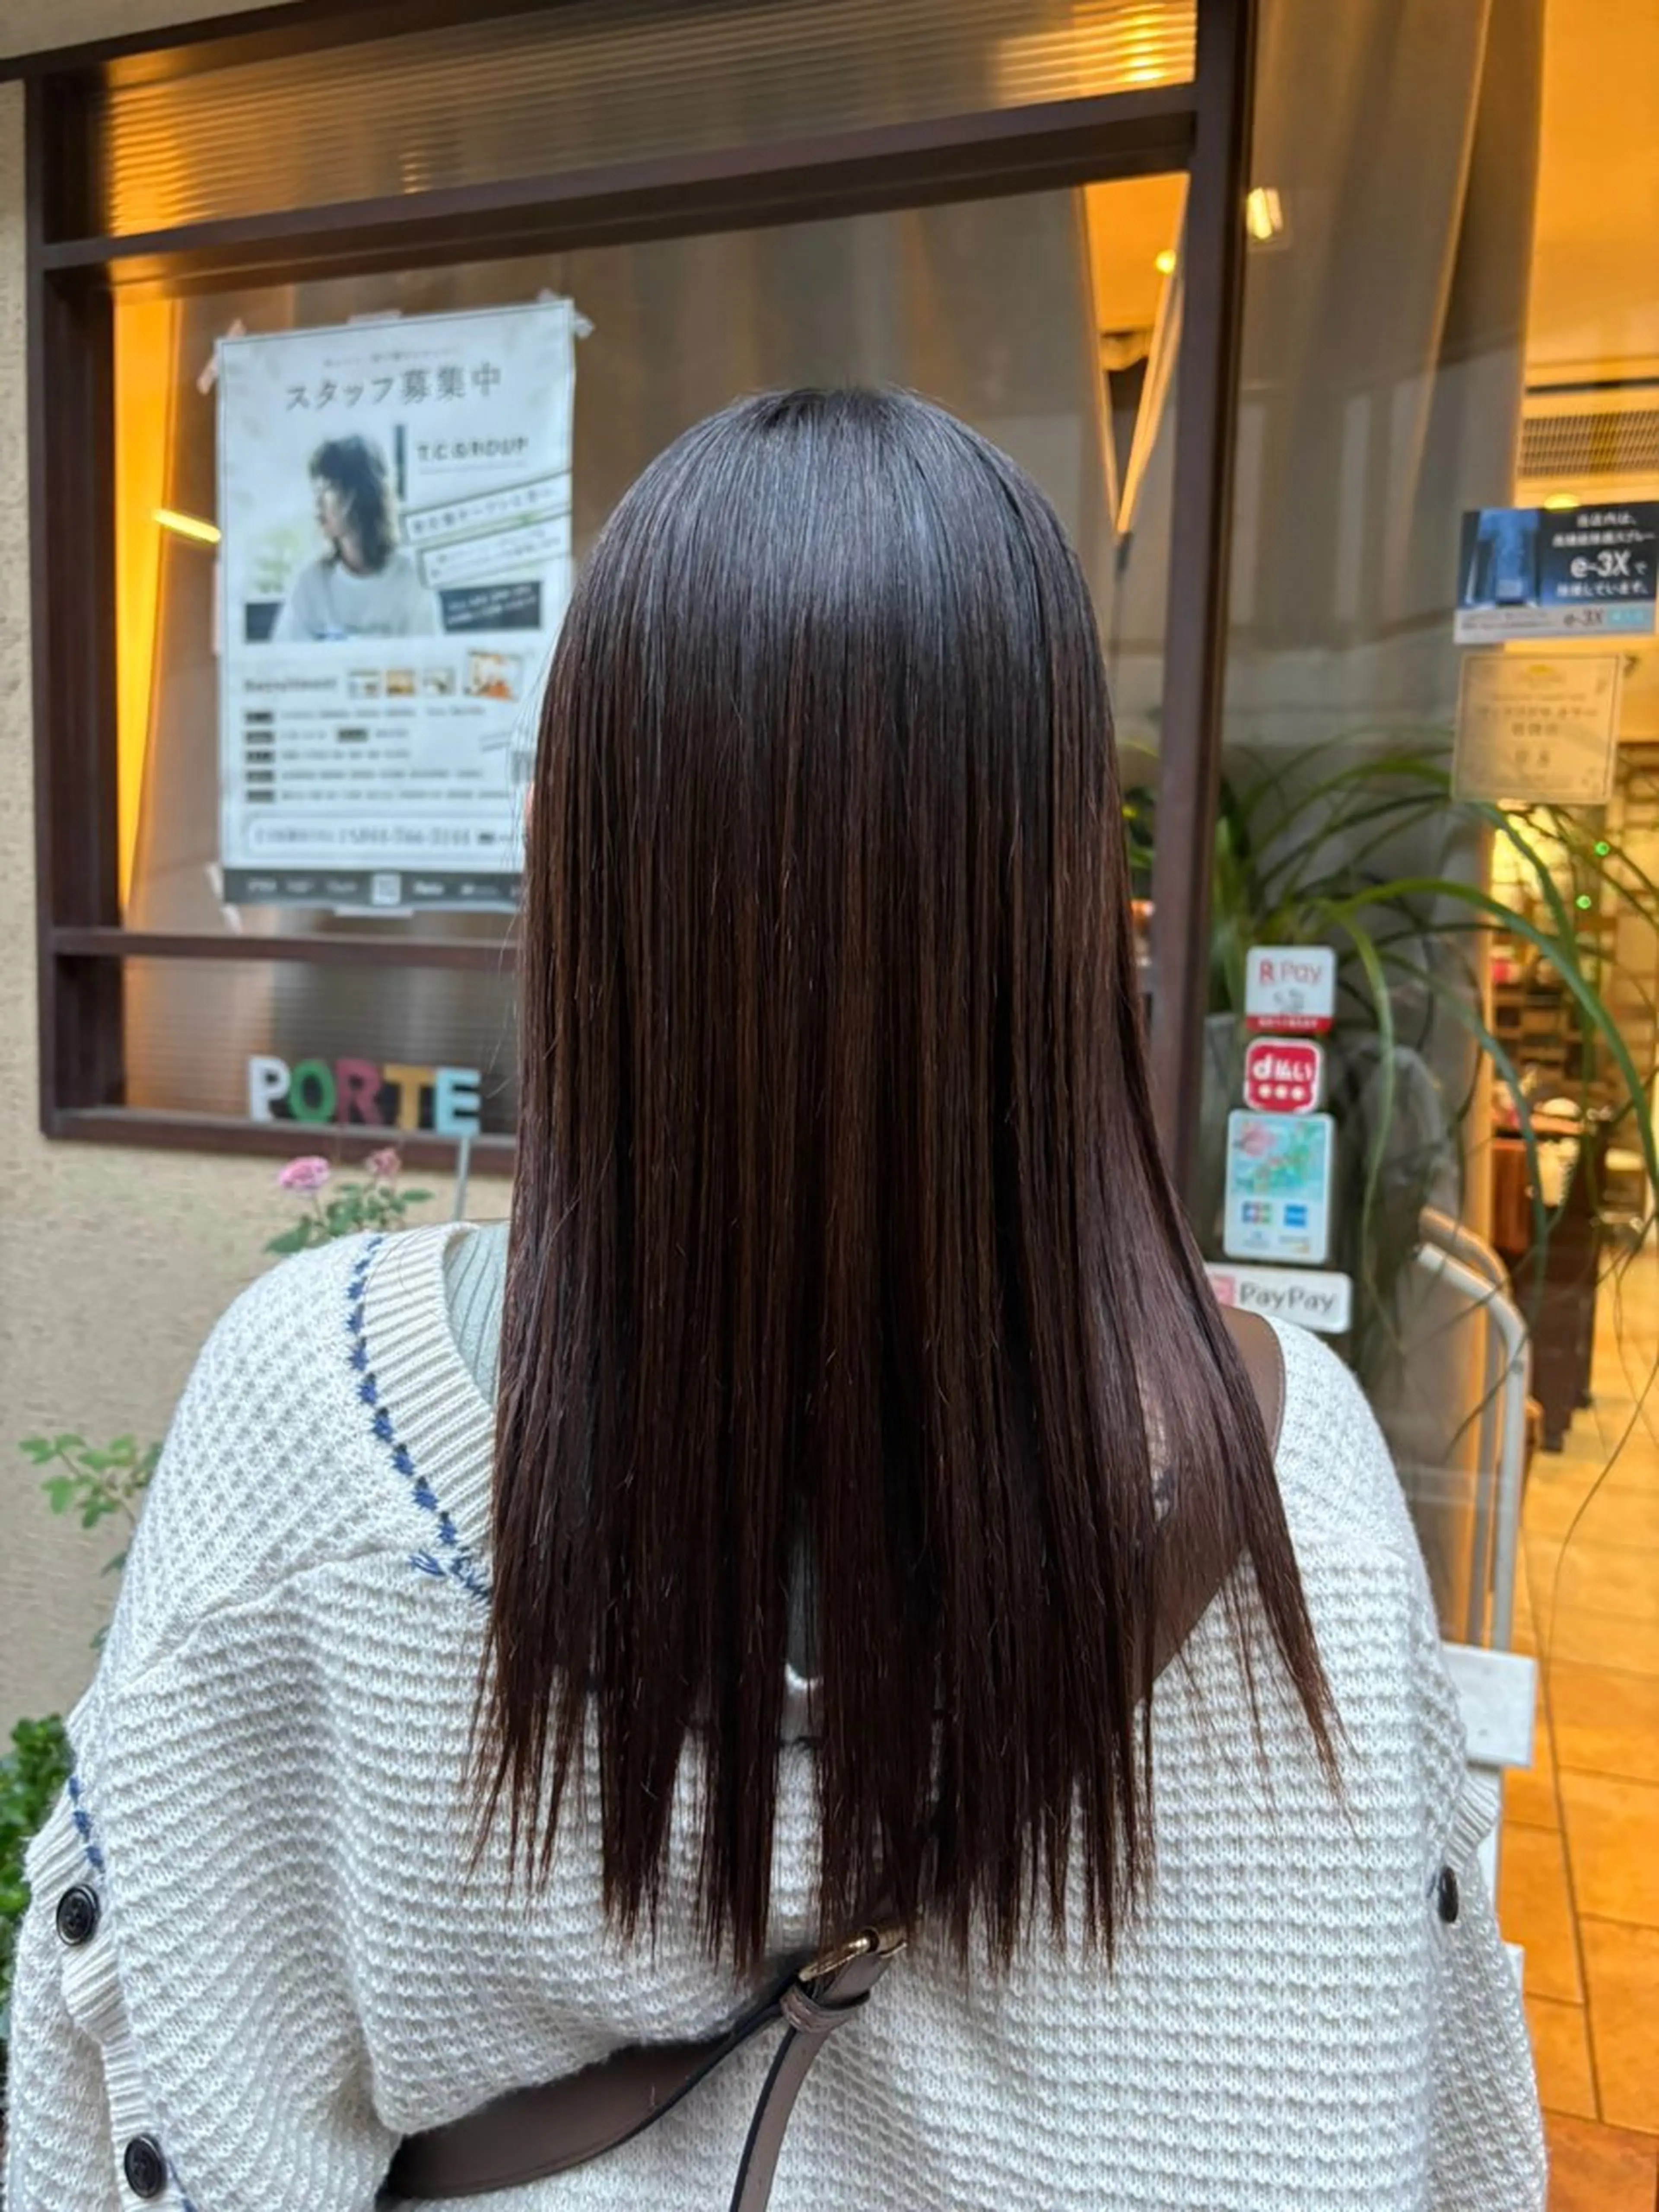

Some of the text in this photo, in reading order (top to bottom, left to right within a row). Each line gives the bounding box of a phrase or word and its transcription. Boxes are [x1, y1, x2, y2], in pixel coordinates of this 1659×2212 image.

[286, 361, 502, 412] スタッフ募集中
[1569, 549, 1632, 579] e-3X
[1279, 959, 1322, 986] Pay
[248, 1055, 481, 1138] PORTE
[1239, 1281, 1337, 1315] PayPay
